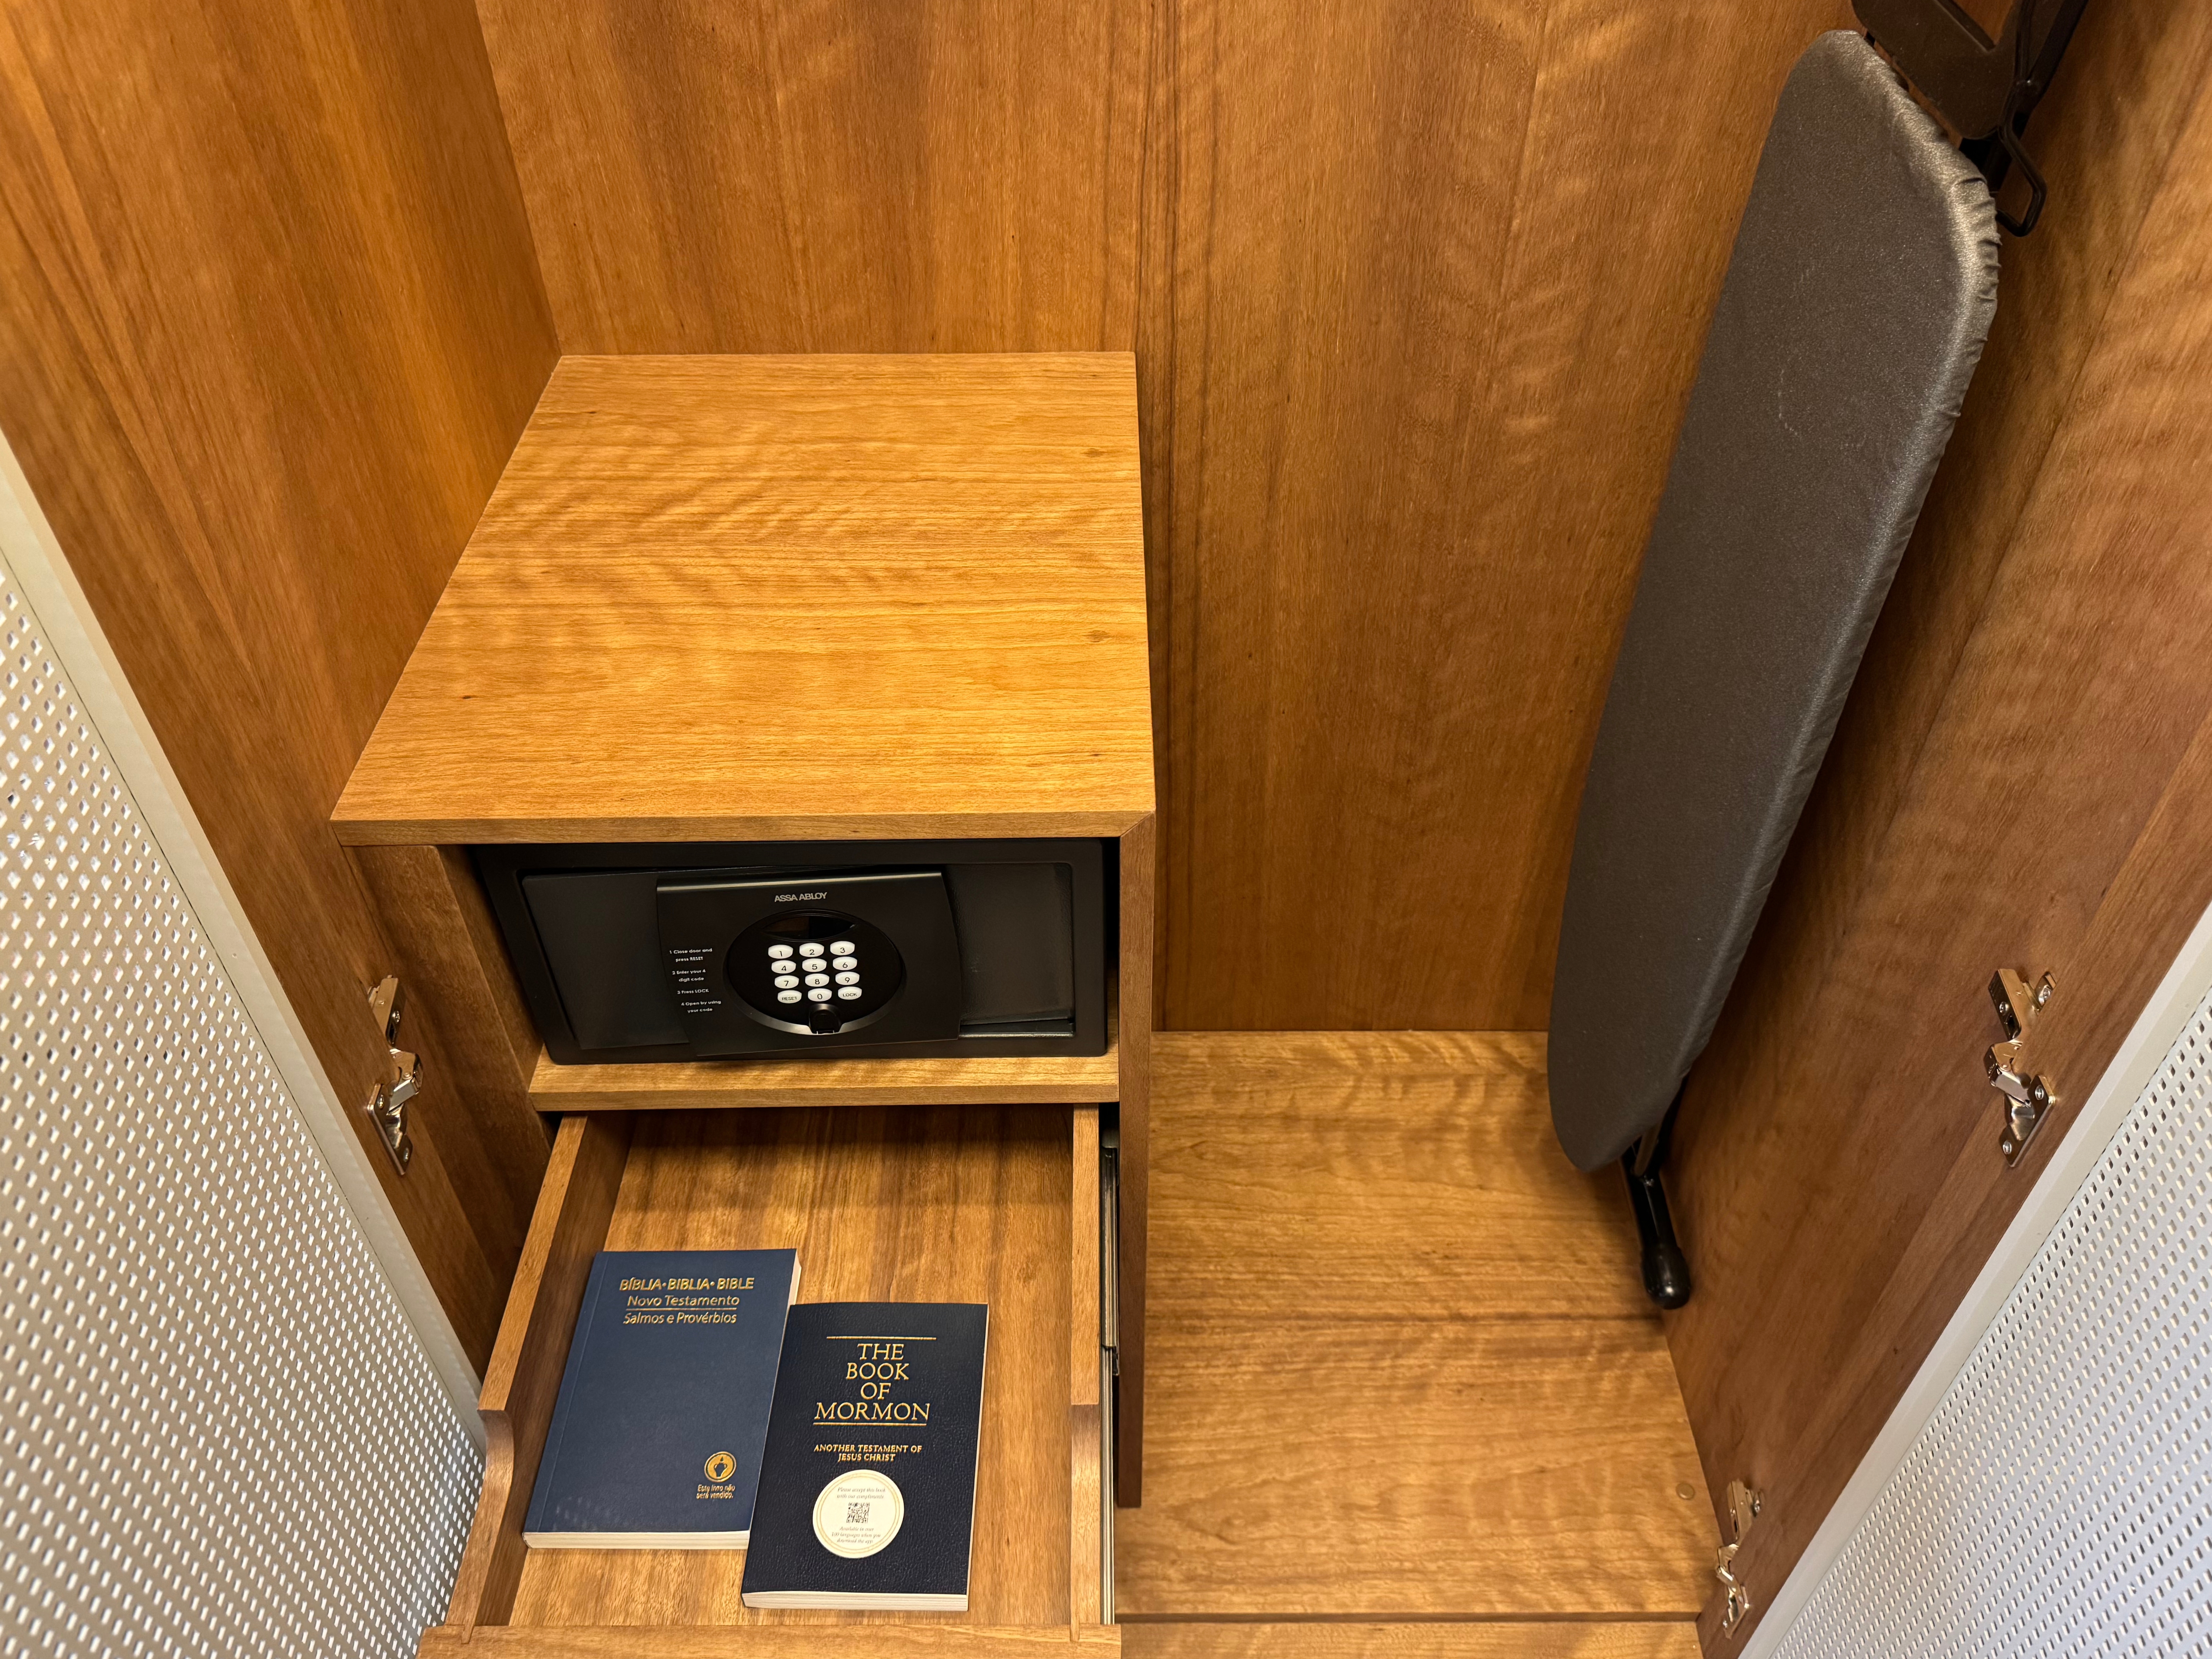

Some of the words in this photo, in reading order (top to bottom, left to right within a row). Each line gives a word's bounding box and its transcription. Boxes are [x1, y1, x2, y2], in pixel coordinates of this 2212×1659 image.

[627, 1295, 662, 1307] Novo
[665, 1295, 740, 1306] Testamento
[623, 1312, 664, 1324] Salmos
[667, 1315, 674, 1324] e
[677, 1312, 737, 1324] Provérbios
[857, 1343, 904, 1360] THE
[846, 1362, 909, 1380] BOOK
[860, 1382, 891, 1400] OF
[814, 1402, 930, 1420] MORMON
[814, 1444, 855, 1452] ANOTHER
[858, 1444, 908, 1453] TESTAMENT
[838, 1453, 862, 1462] JESUS
[864, 1453, 896, 1462] CHRIST
